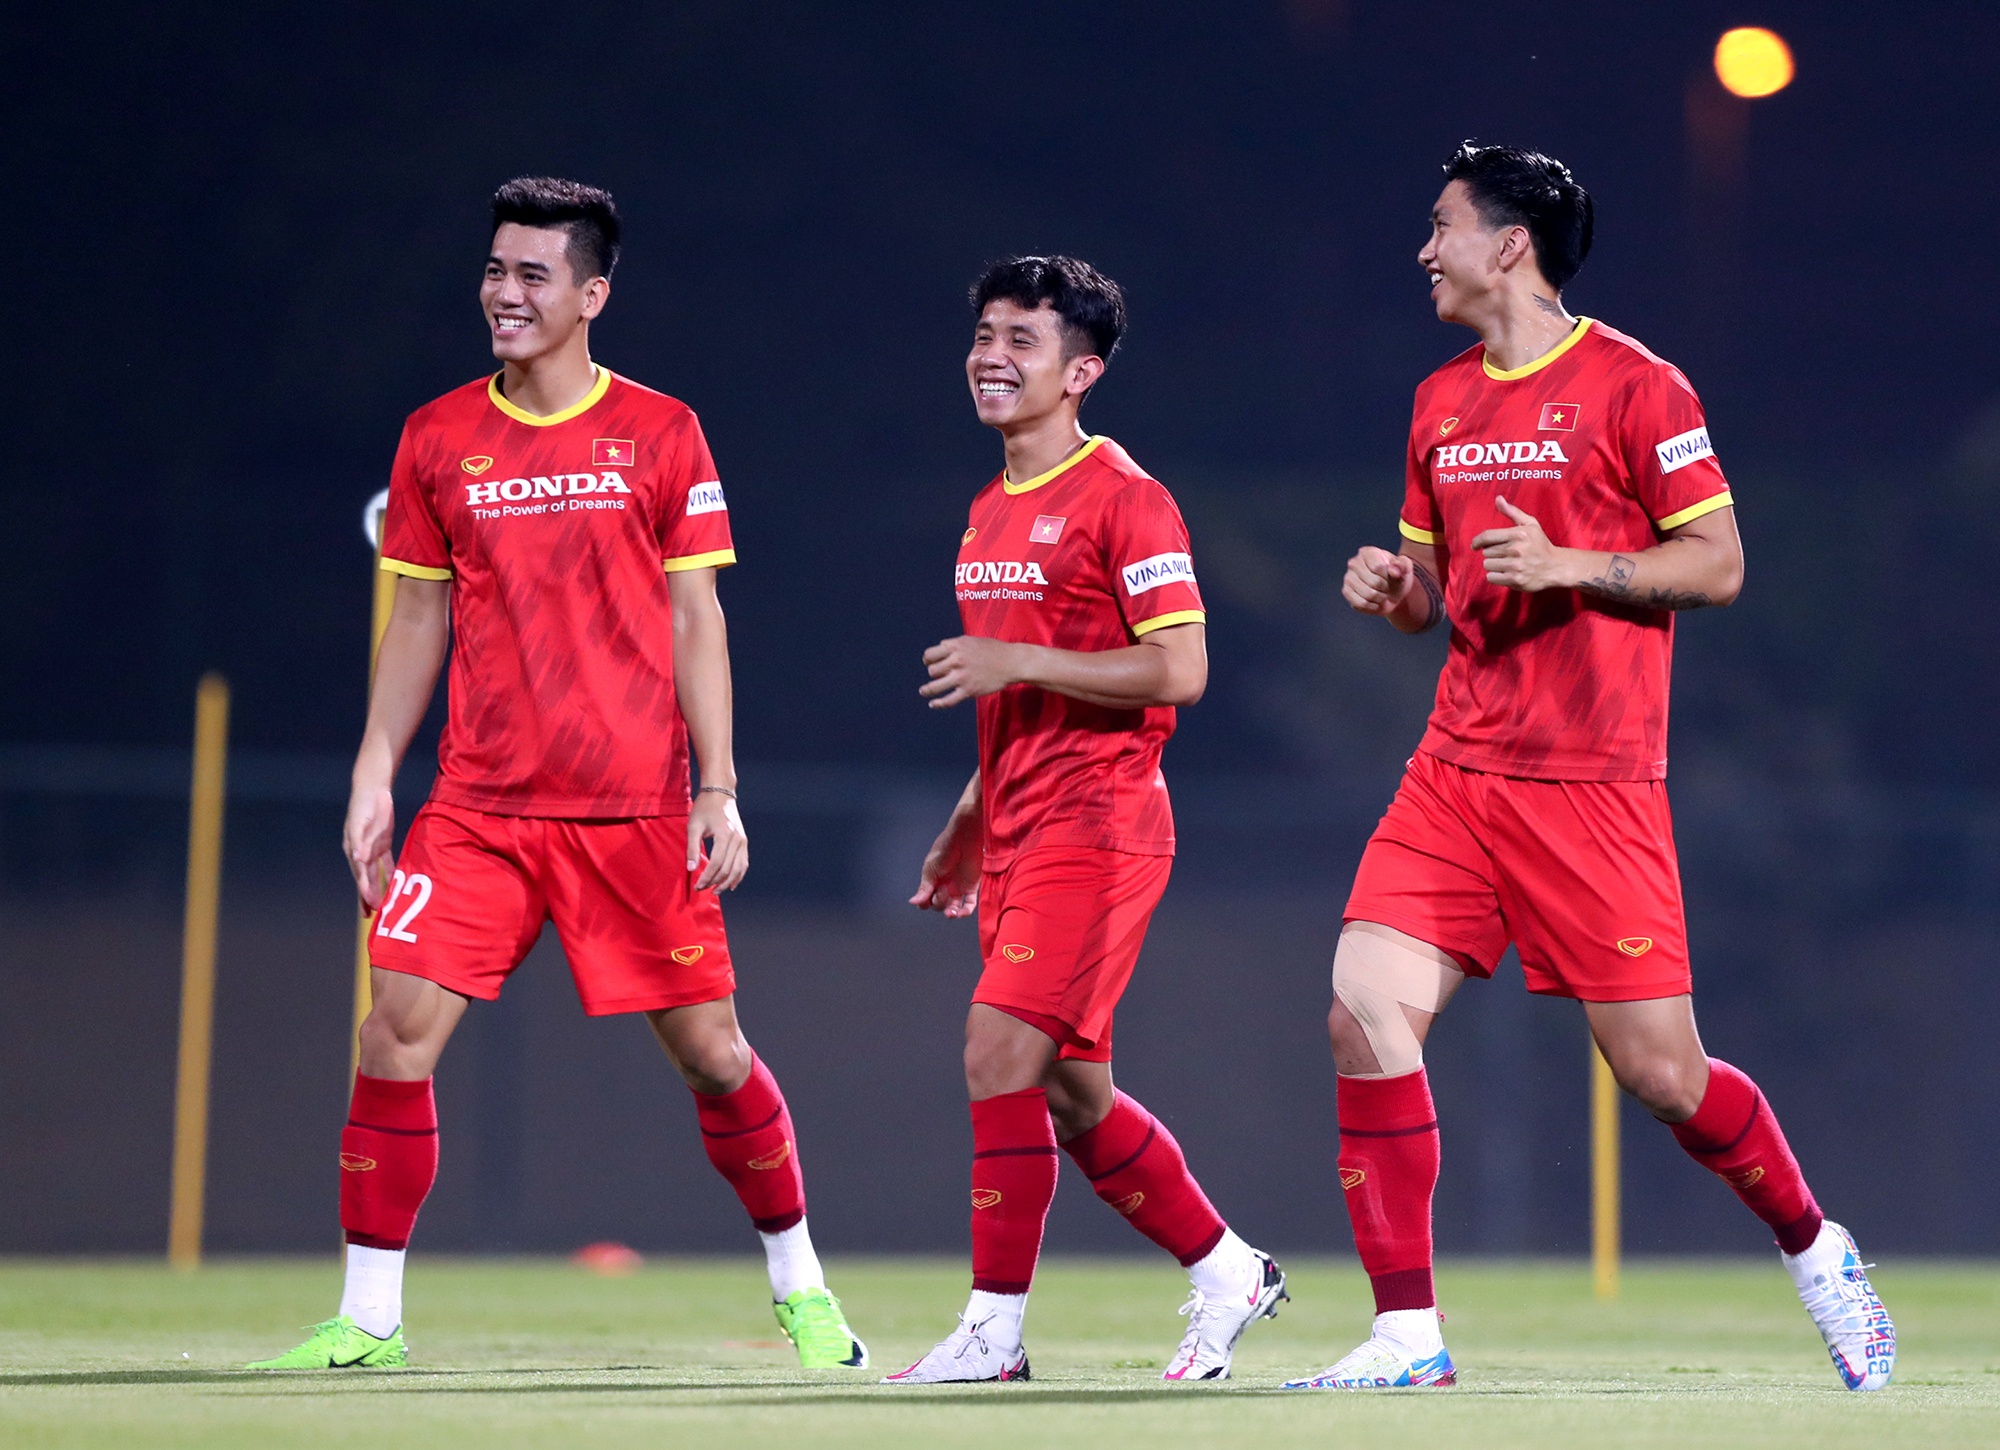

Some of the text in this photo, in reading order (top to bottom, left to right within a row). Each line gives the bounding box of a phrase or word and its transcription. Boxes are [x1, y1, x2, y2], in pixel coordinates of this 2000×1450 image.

[1436, 440, 1569, 468] HONDA
[465, 471, 632, 506] HONDA
[1438, 468, 1562, 484] The Power of Dreams
[472, 499, 625, 520] The Power of Dreams
[955, 561, 1049, 586] HONDA
[956, 587, 1044, 602] he Power of Dreams
[376, 869, 433, 944] 22
